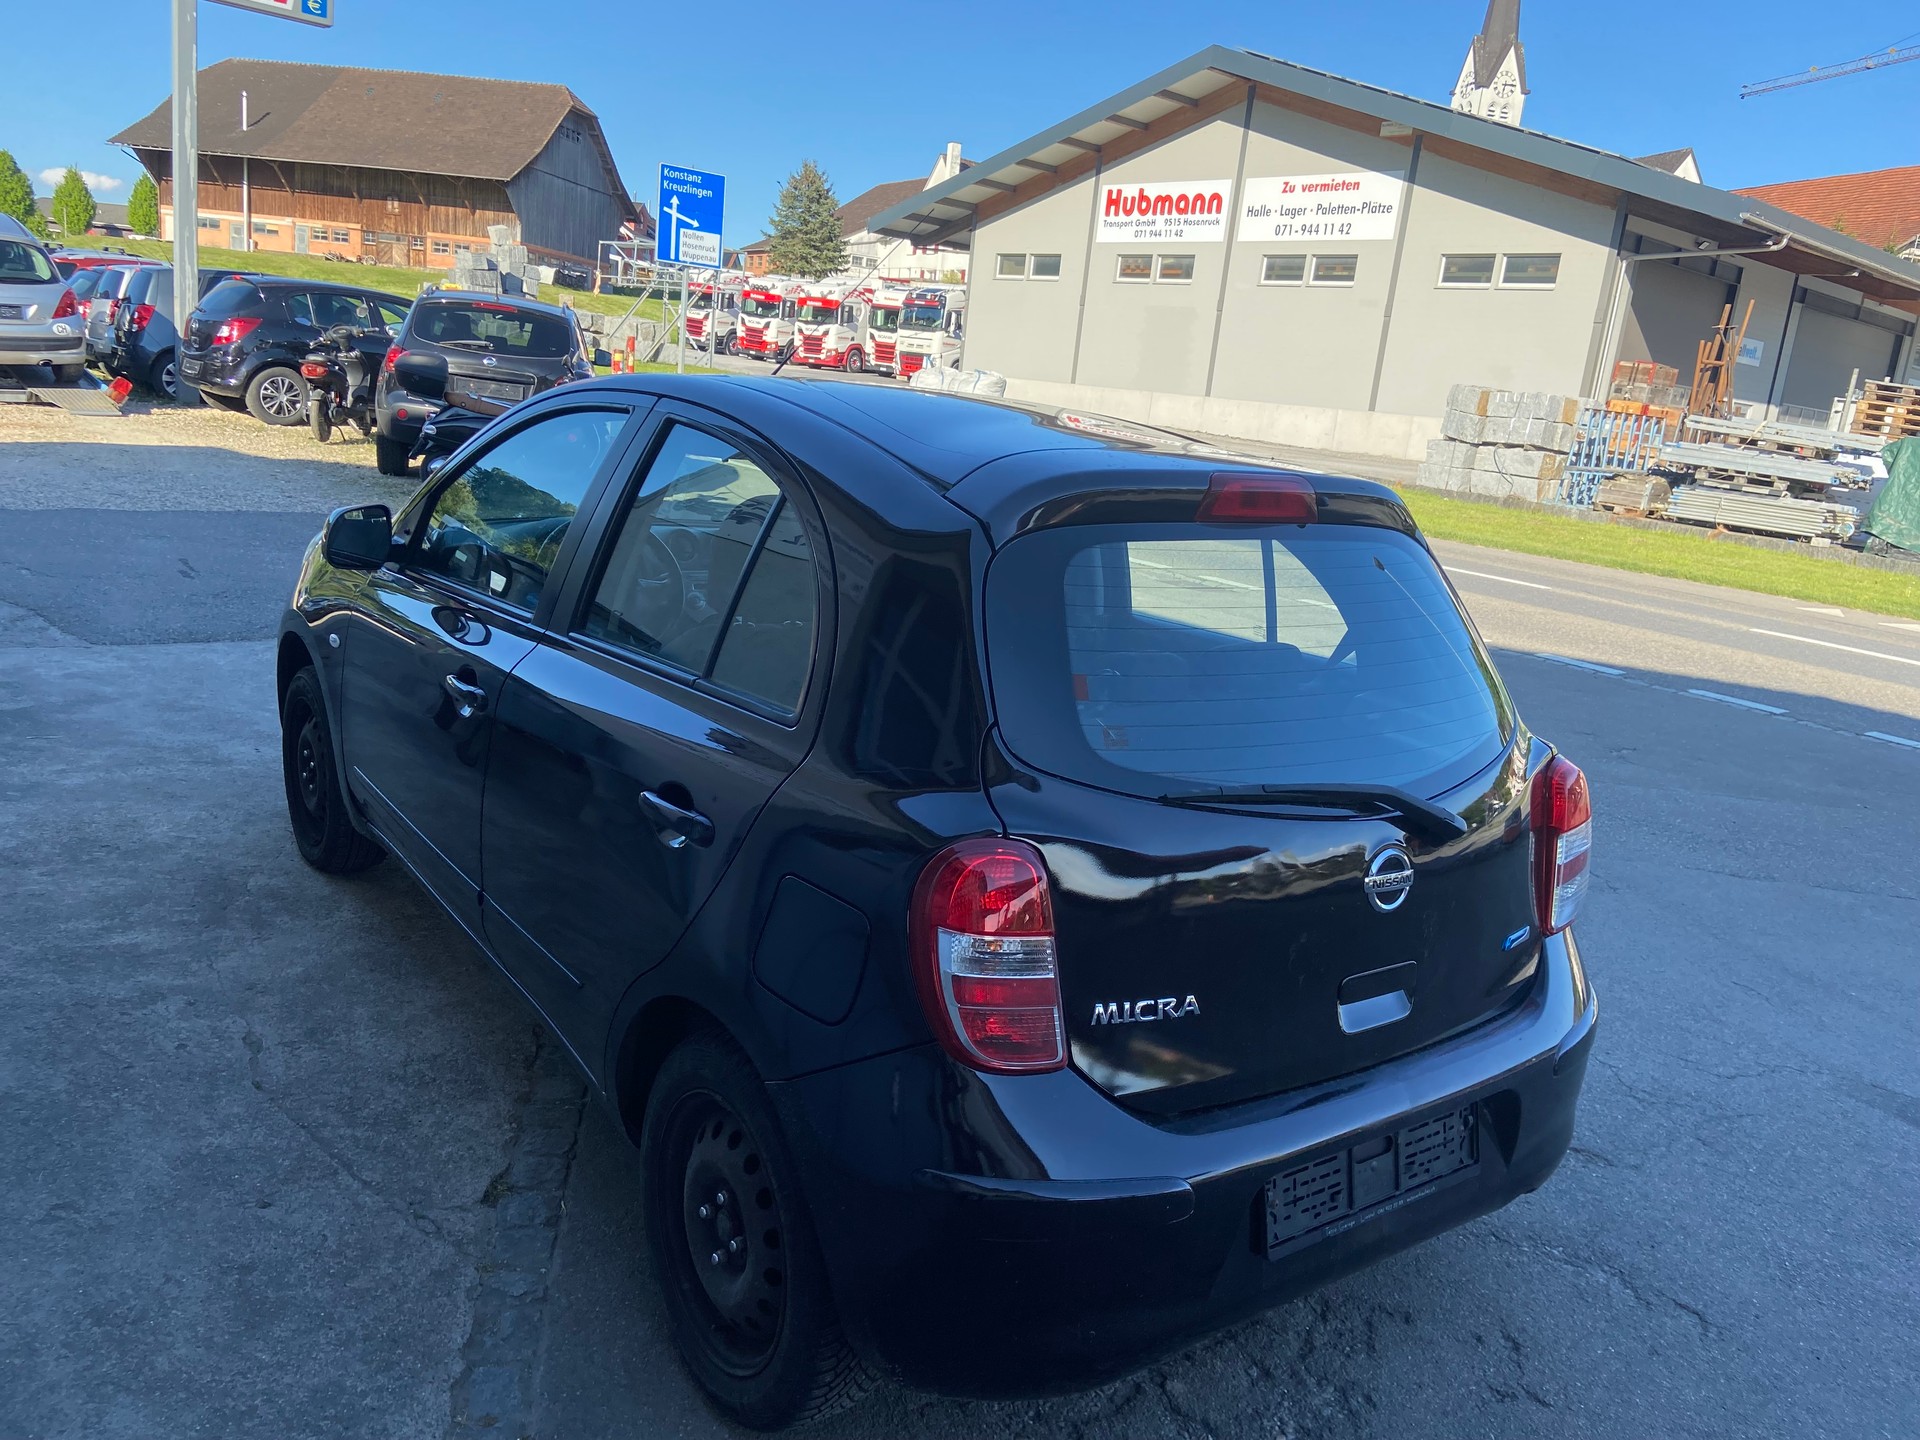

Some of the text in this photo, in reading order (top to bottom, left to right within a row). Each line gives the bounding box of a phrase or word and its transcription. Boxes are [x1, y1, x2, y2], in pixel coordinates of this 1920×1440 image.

[664, 167, 702, 184] Konstanz
[663, 180, 713, 198] Kreuzlingen
[1281, 178, 1361, 194] Zu vermieten
[1104, 188, 1223, 217] Hubmann
[1246, 201, 1393, 219] Halle Lager Paletten-Plätze
[1103, 217, 1221, 229] Transport GmbH 9515 Hosenruck
[1323, 223, 1335, 236] 11
[1338, 222, 1352, 235] 42
[682, 231, 704, 241] Nollen
[1134, 229, 1184, 238] 071 944 11 42
[682, 241, 716, 252] Hosenruck
[681, 251, 717, 262] Wuppenau
[56, 324, 68, 334] CH
[1372, 874, 1413, 889] NISSAN
[1091, 994, 1201, 1026] MICRA
